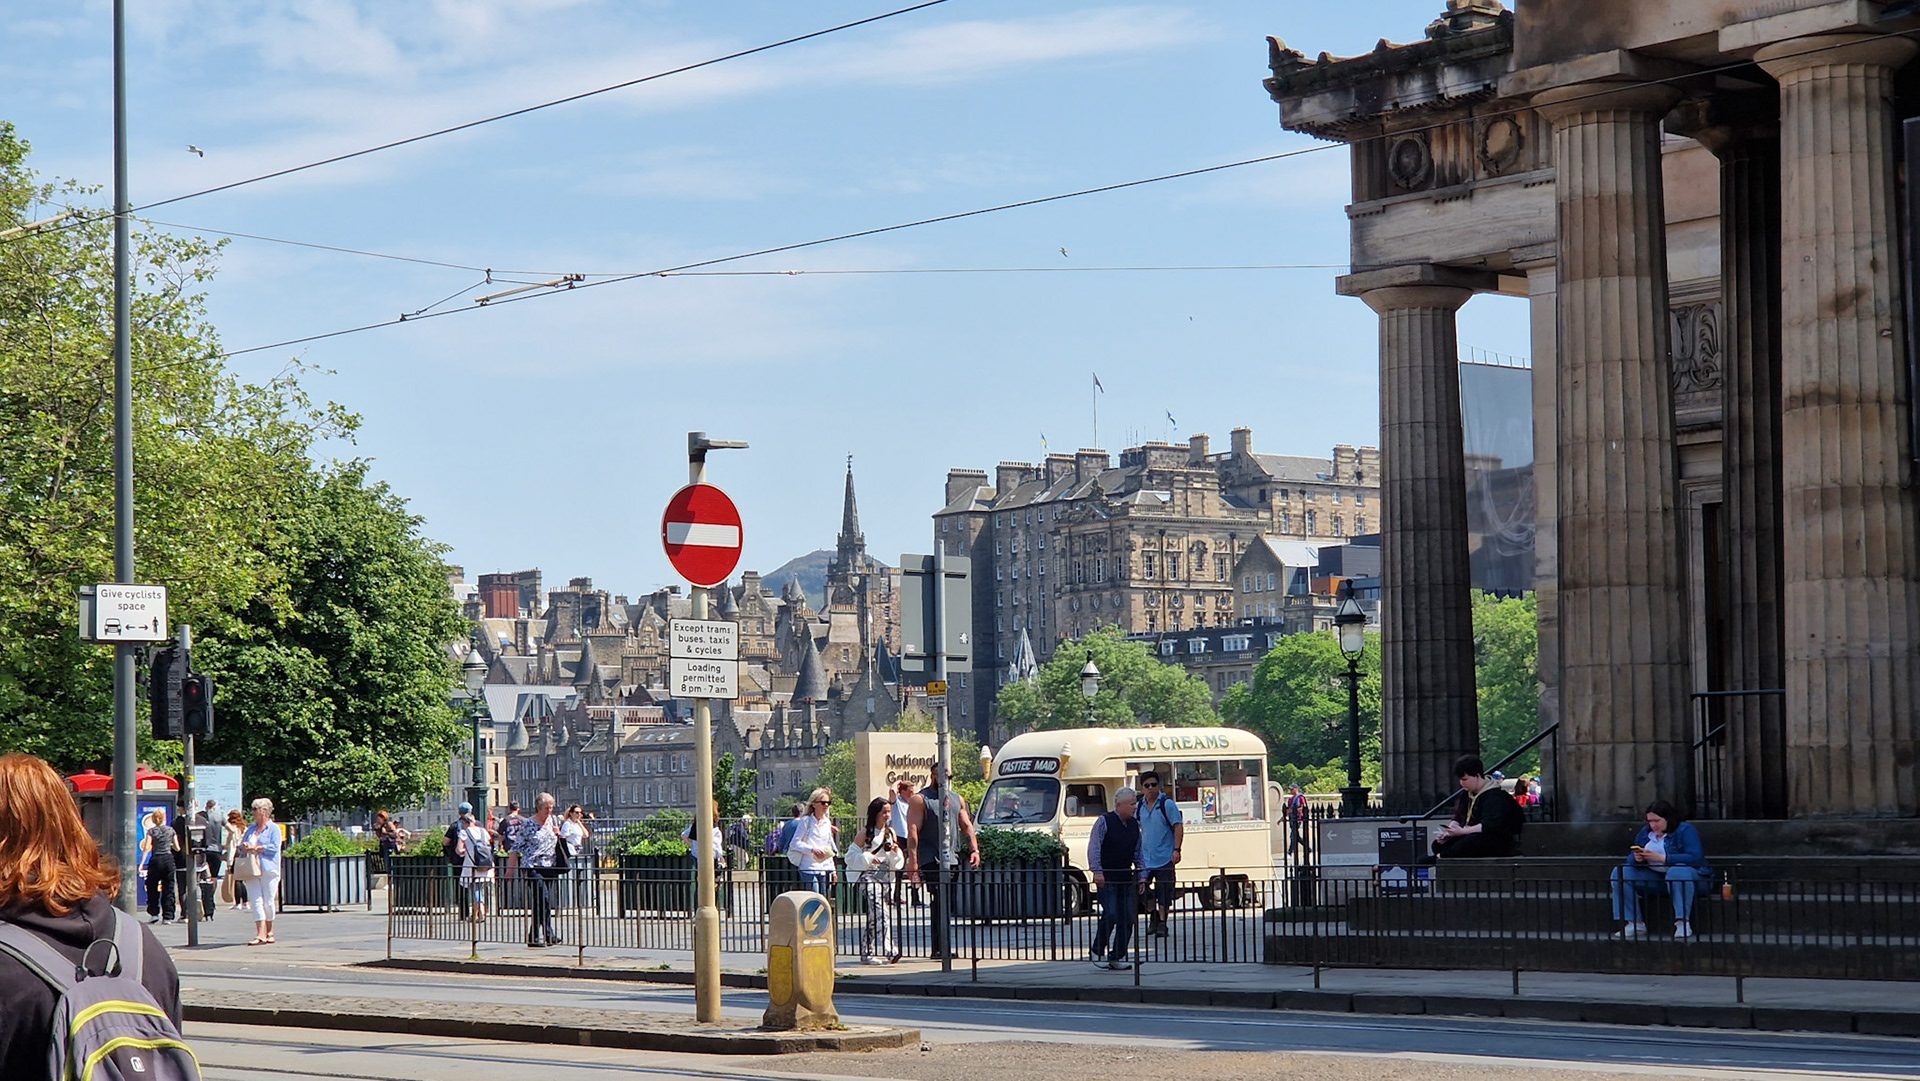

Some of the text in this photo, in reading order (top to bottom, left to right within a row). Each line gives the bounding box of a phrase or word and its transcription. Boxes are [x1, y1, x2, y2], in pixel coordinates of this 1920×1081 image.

[101, 589, 161, 600] Give cyclists
[118, 603, 145, 611] space
[674, 623, 704, 633] Except
[709, 636, 730, 644] taxis
[686, 645, 722, 655] & cycles
[688, 663, 720, 674] Loading
[683, 674, 725, 683] permitted
[1128, 735, 1230, 752] ICE CREAMS
[886, 754, 936, 768] National
[1034, 760, 1057, 772] MAID
[887, 771, 928, 788] Gallery
